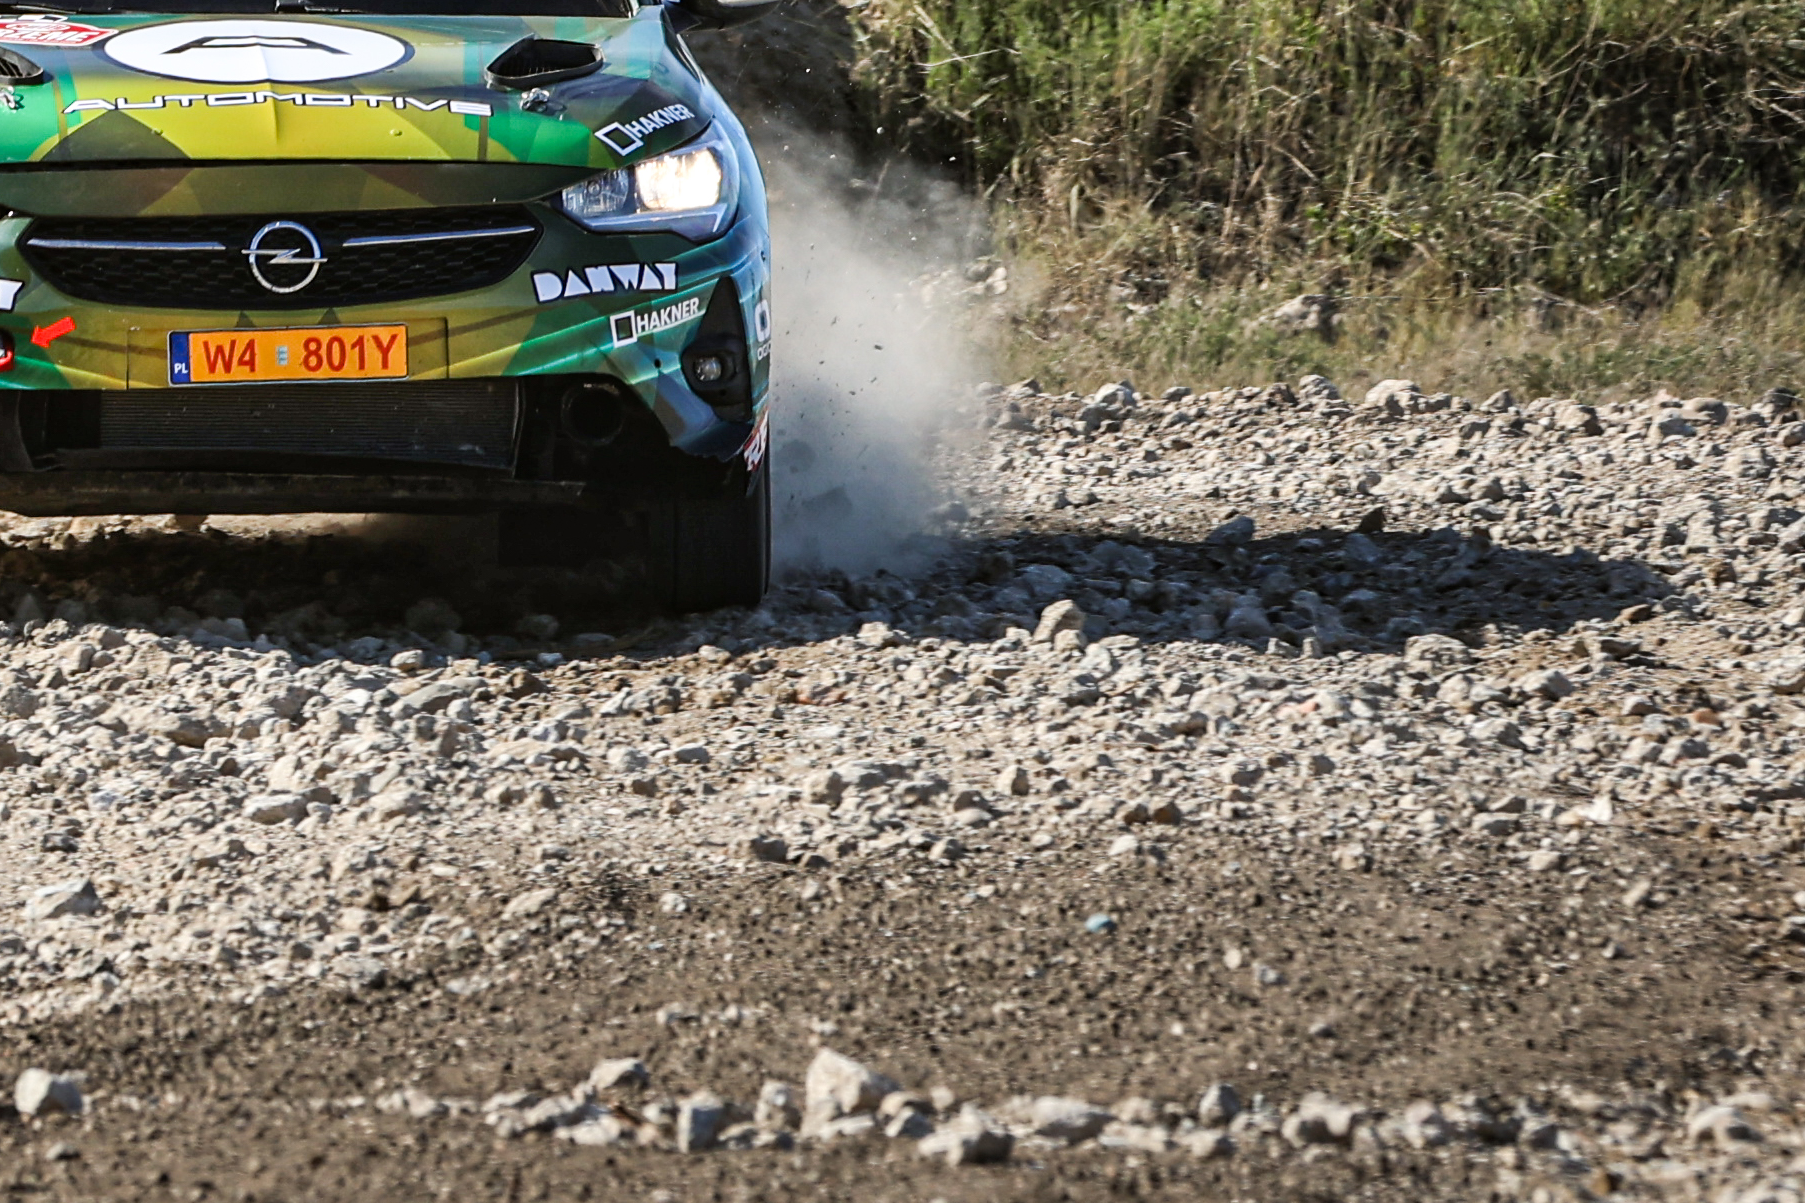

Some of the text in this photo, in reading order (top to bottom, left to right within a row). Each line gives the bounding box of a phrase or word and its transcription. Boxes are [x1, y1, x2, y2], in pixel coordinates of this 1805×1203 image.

[63, 91, 494, 117] AUTOMOTIVE
[624, 102, 695, 145] HAKNER
[532, 261, 679, 303] DANWAY
[636, 297, 700, 334] HAKNER
[174, 362, 189, 374] PL
[202, 333, 399, 375] W4 801Y
